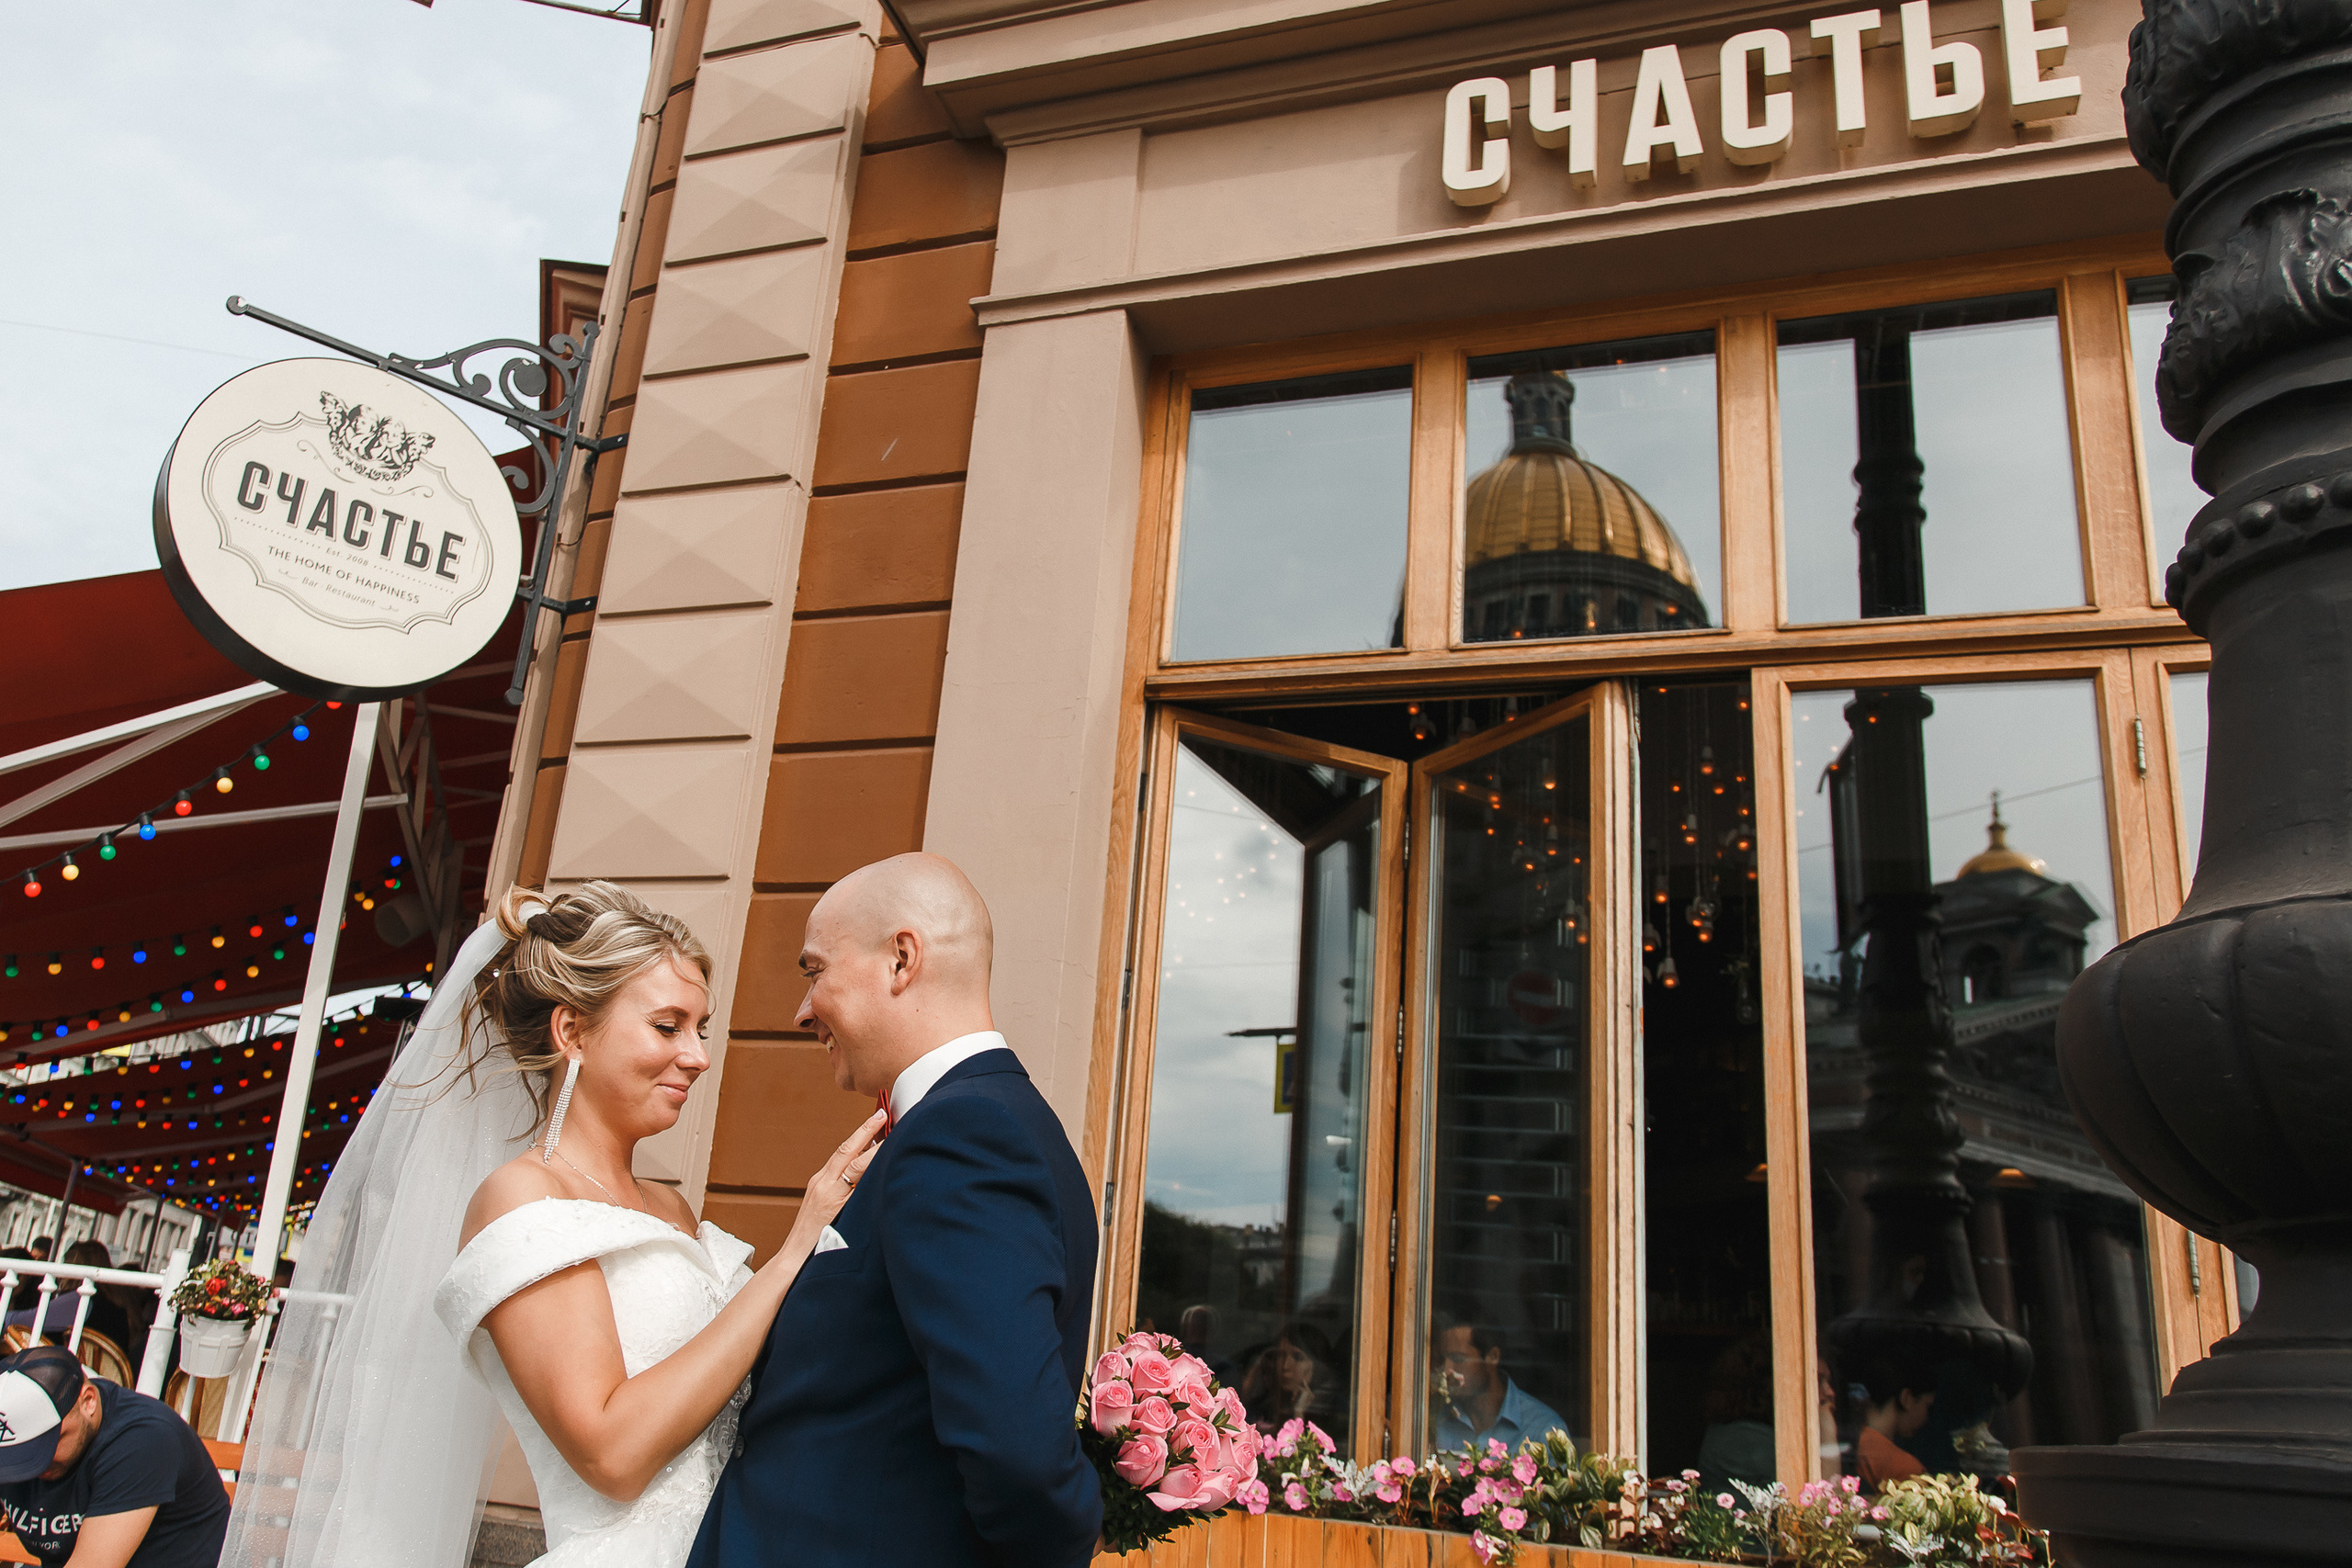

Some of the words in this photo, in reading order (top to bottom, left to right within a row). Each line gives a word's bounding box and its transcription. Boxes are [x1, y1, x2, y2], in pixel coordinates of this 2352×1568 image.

[1442, 0, 2081, 198] СЧАСТЬЕ
[237, 460, 466, 583] СЧАСТЬЕ
[268, 545, 291, 561] THE
[294, 555, 332, 575] HOME
[335, 569, 353, 581] OF
[356, 575, 421, 604] HAPPINESS
[325, 547, 344, 558] Est.
[346, 554, 369, 567] 2008
[302, 576, 319, 588] Bar
[325, 583, 376, 606] Restaurant
